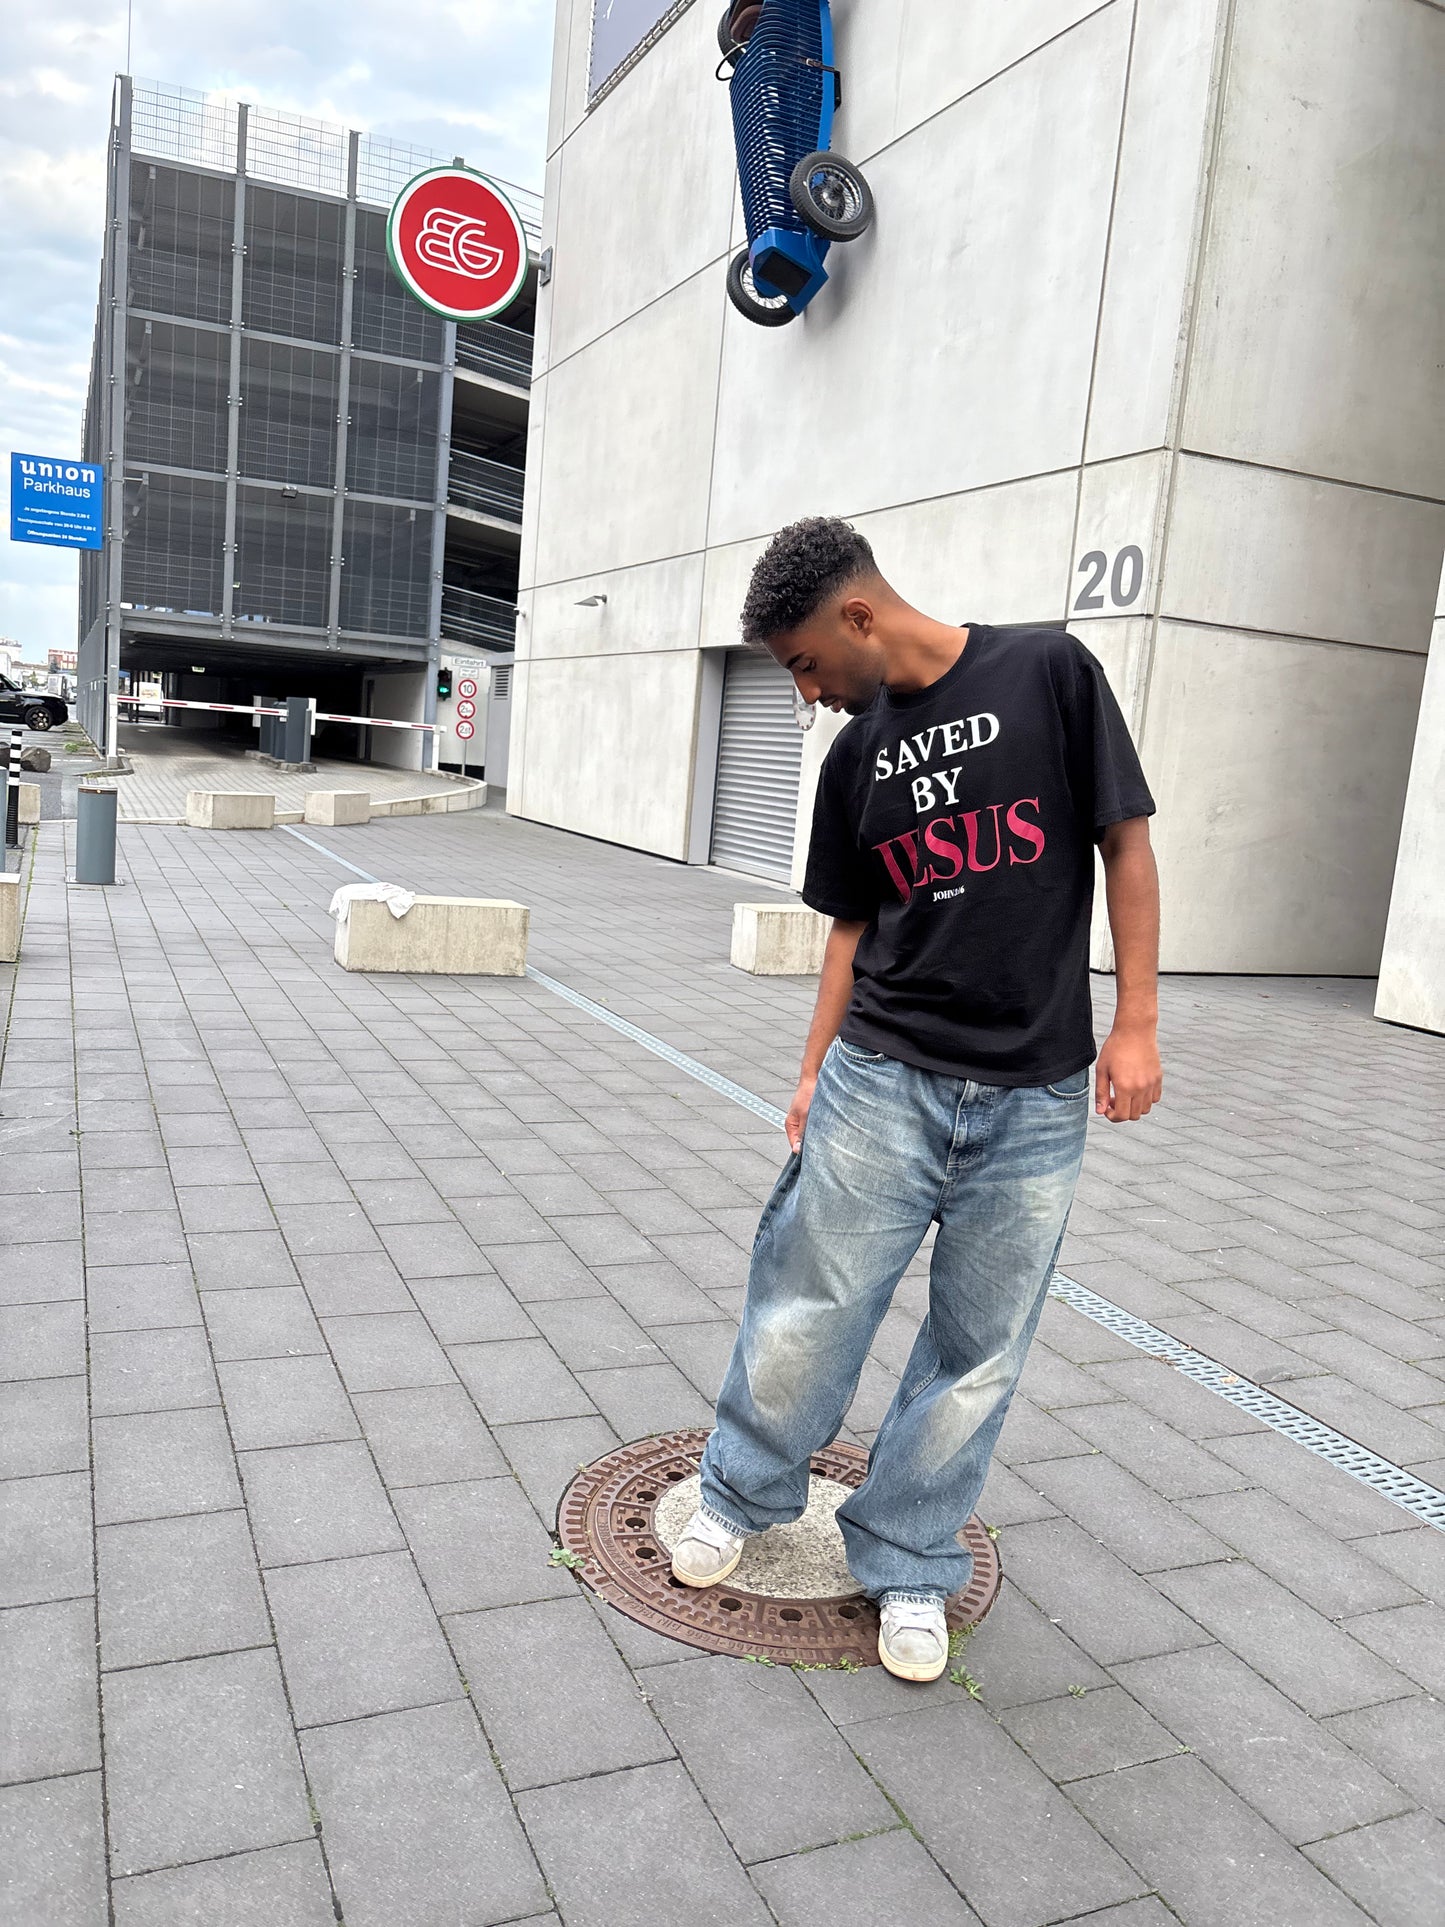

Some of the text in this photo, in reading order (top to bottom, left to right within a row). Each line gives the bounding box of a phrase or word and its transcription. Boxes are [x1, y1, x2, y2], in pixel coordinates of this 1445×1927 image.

[20, 460, 95, 483] union
[23, 477, 91, 499] Parkhaus
[1073, 544, 1144, 611] 20
[454, 658, 484, 666] Einfahrt
[463, 684, 473, 694] 10
[875, 712, 1000, 781] SAVED
[911, 766, 962, 814] BY
